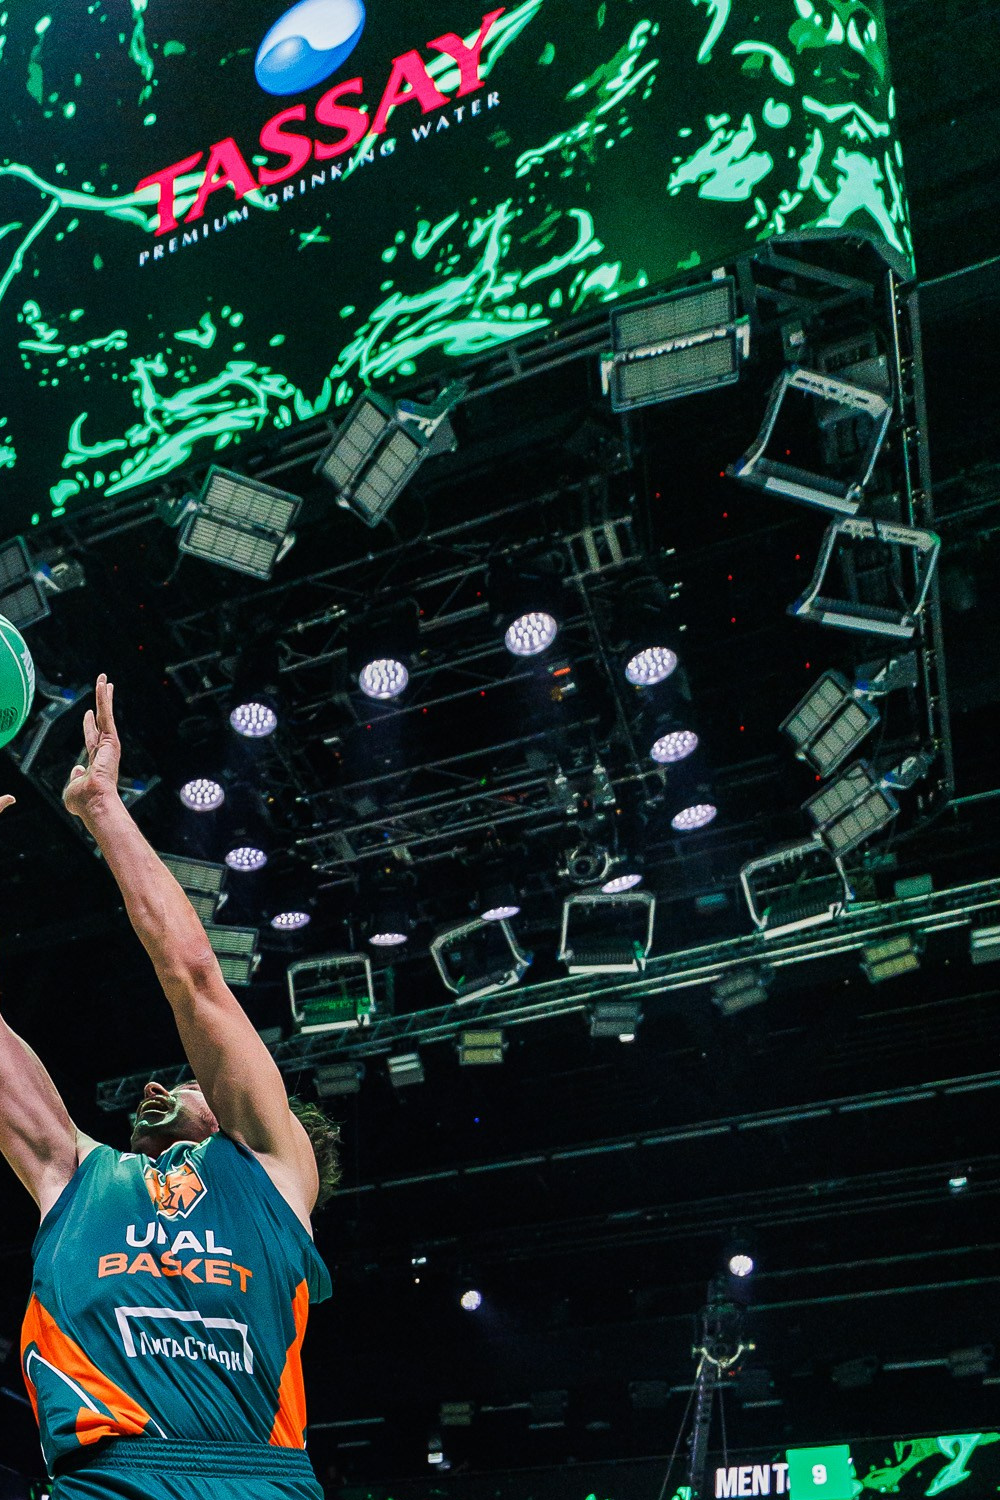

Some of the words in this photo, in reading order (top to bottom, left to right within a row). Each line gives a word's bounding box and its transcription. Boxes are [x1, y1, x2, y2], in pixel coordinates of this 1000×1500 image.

[134, 7, 506, 237] TASSAY
[139, 204, 249, 267] PREMIUM
[264, 138, 397, 207] DRINKING
[411, 91, 501, 143] WATER
[98, 1249, 253, 1294] BASKET
[812, 1464, 827, 1485] 9
